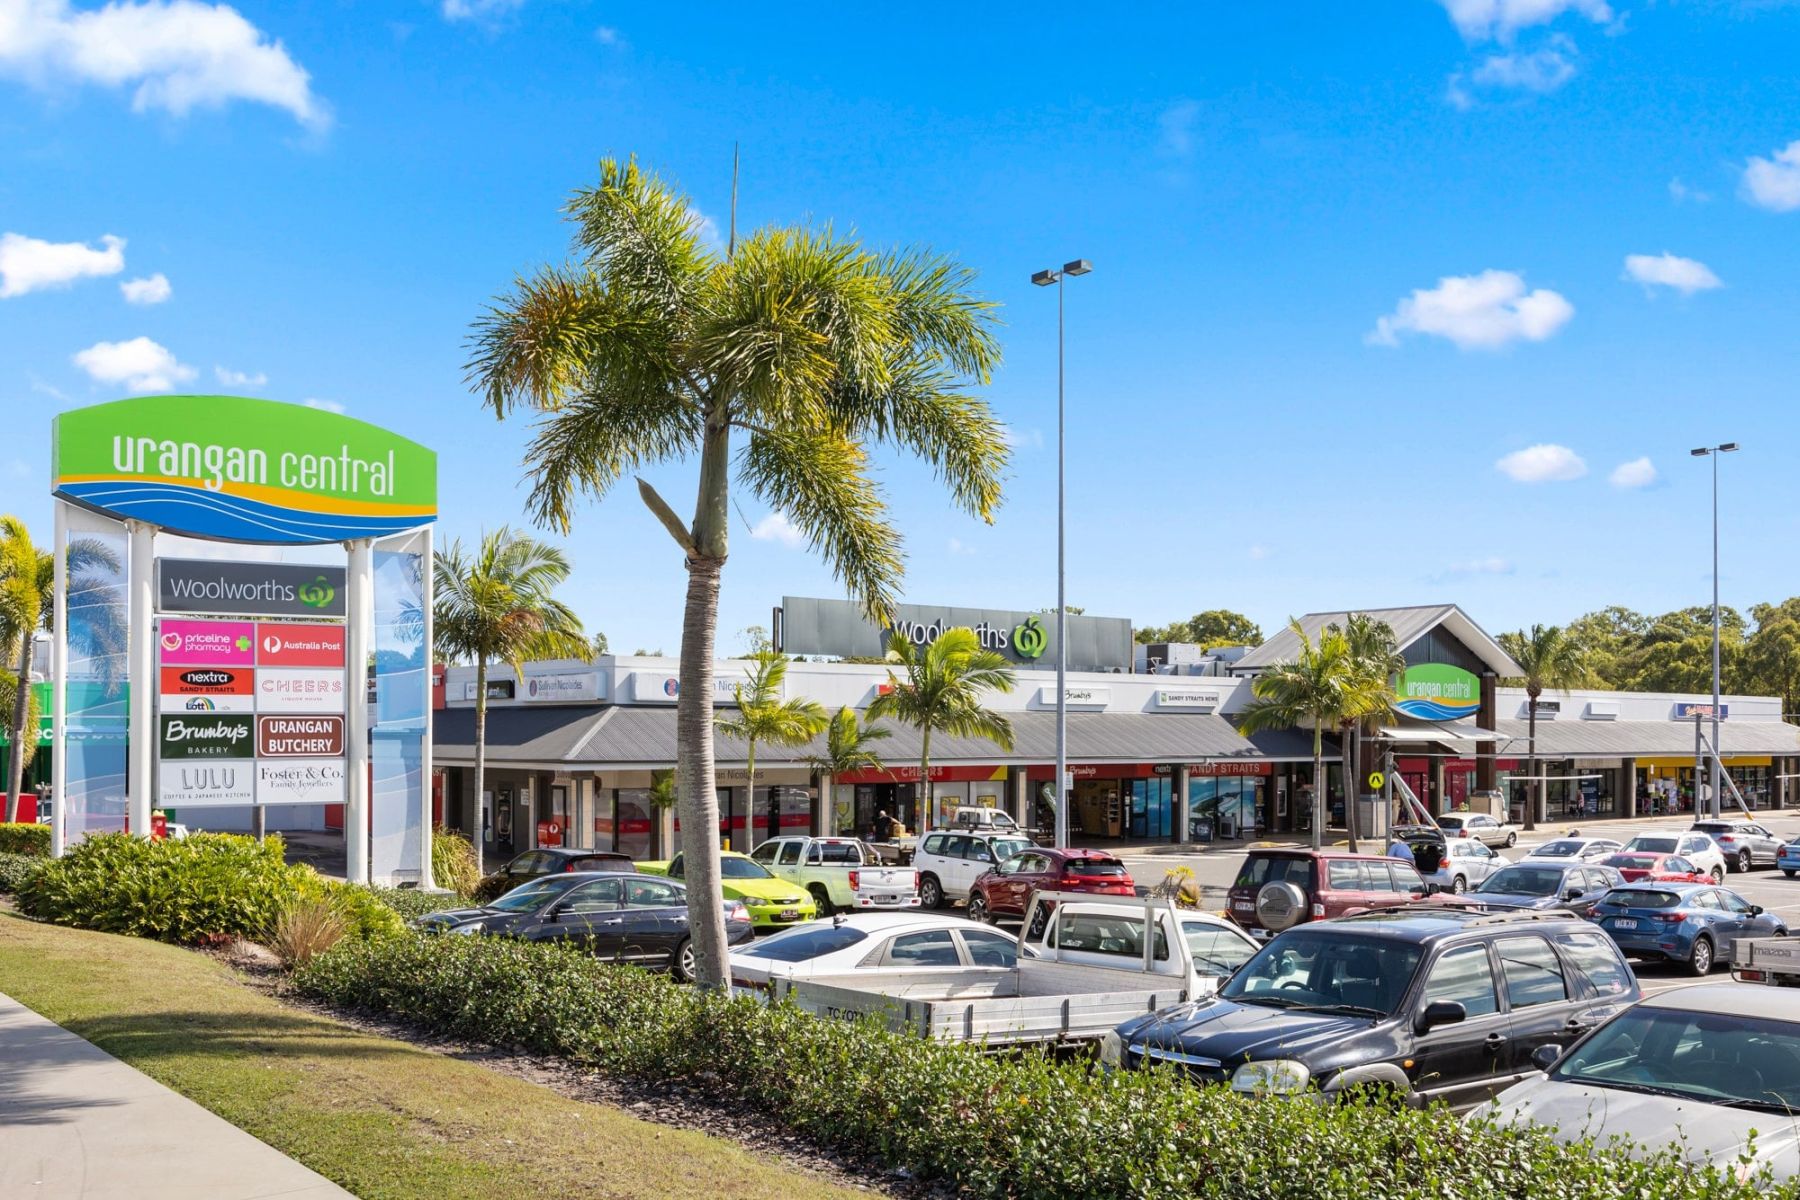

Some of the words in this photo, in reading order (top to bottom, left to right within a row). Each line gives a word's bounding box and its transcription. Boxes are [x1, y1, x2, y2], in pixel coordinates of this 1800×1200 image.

[113, 435, 267, 492] urangan
[280, 445, 394, 497] central
[170, 577, 295, 602] Woolworths
[894, 617, 1008, 649] Woolrths
[185, 634, 231, 646] priceline
[283, 641, 320, 650] Australia
[322, 642, 341, 651] Post
[185, 643, 231, 654] pharmacy
[187, 671, 229, 683] nextra
[261, 680, 342, 693] CHEERS
[1407, 682, 1441, 700] urangan
[1443, 678, 1471, 699] central
[165, 720, 248, 744] Brumby's
[269, 721, 333, 734] URANGAN
[187, 746, 229, 754] BAKERY
[268, 739, 333, 753] BUTCHERY
[261, 767, 301, 781] Foster
[305, 766, 318, 779] &
[321, 766, 344, 779] Co.
[901, 767, 943, 777] CHERS
[1191, 764, 1217, 774] ANDY
[1220, 763, 1260, 774] STRAITS
[181, 768, 235, 790] LULU
[270, 780, 297, 789] Family
[1754, 947, 1791, 957] mazda
